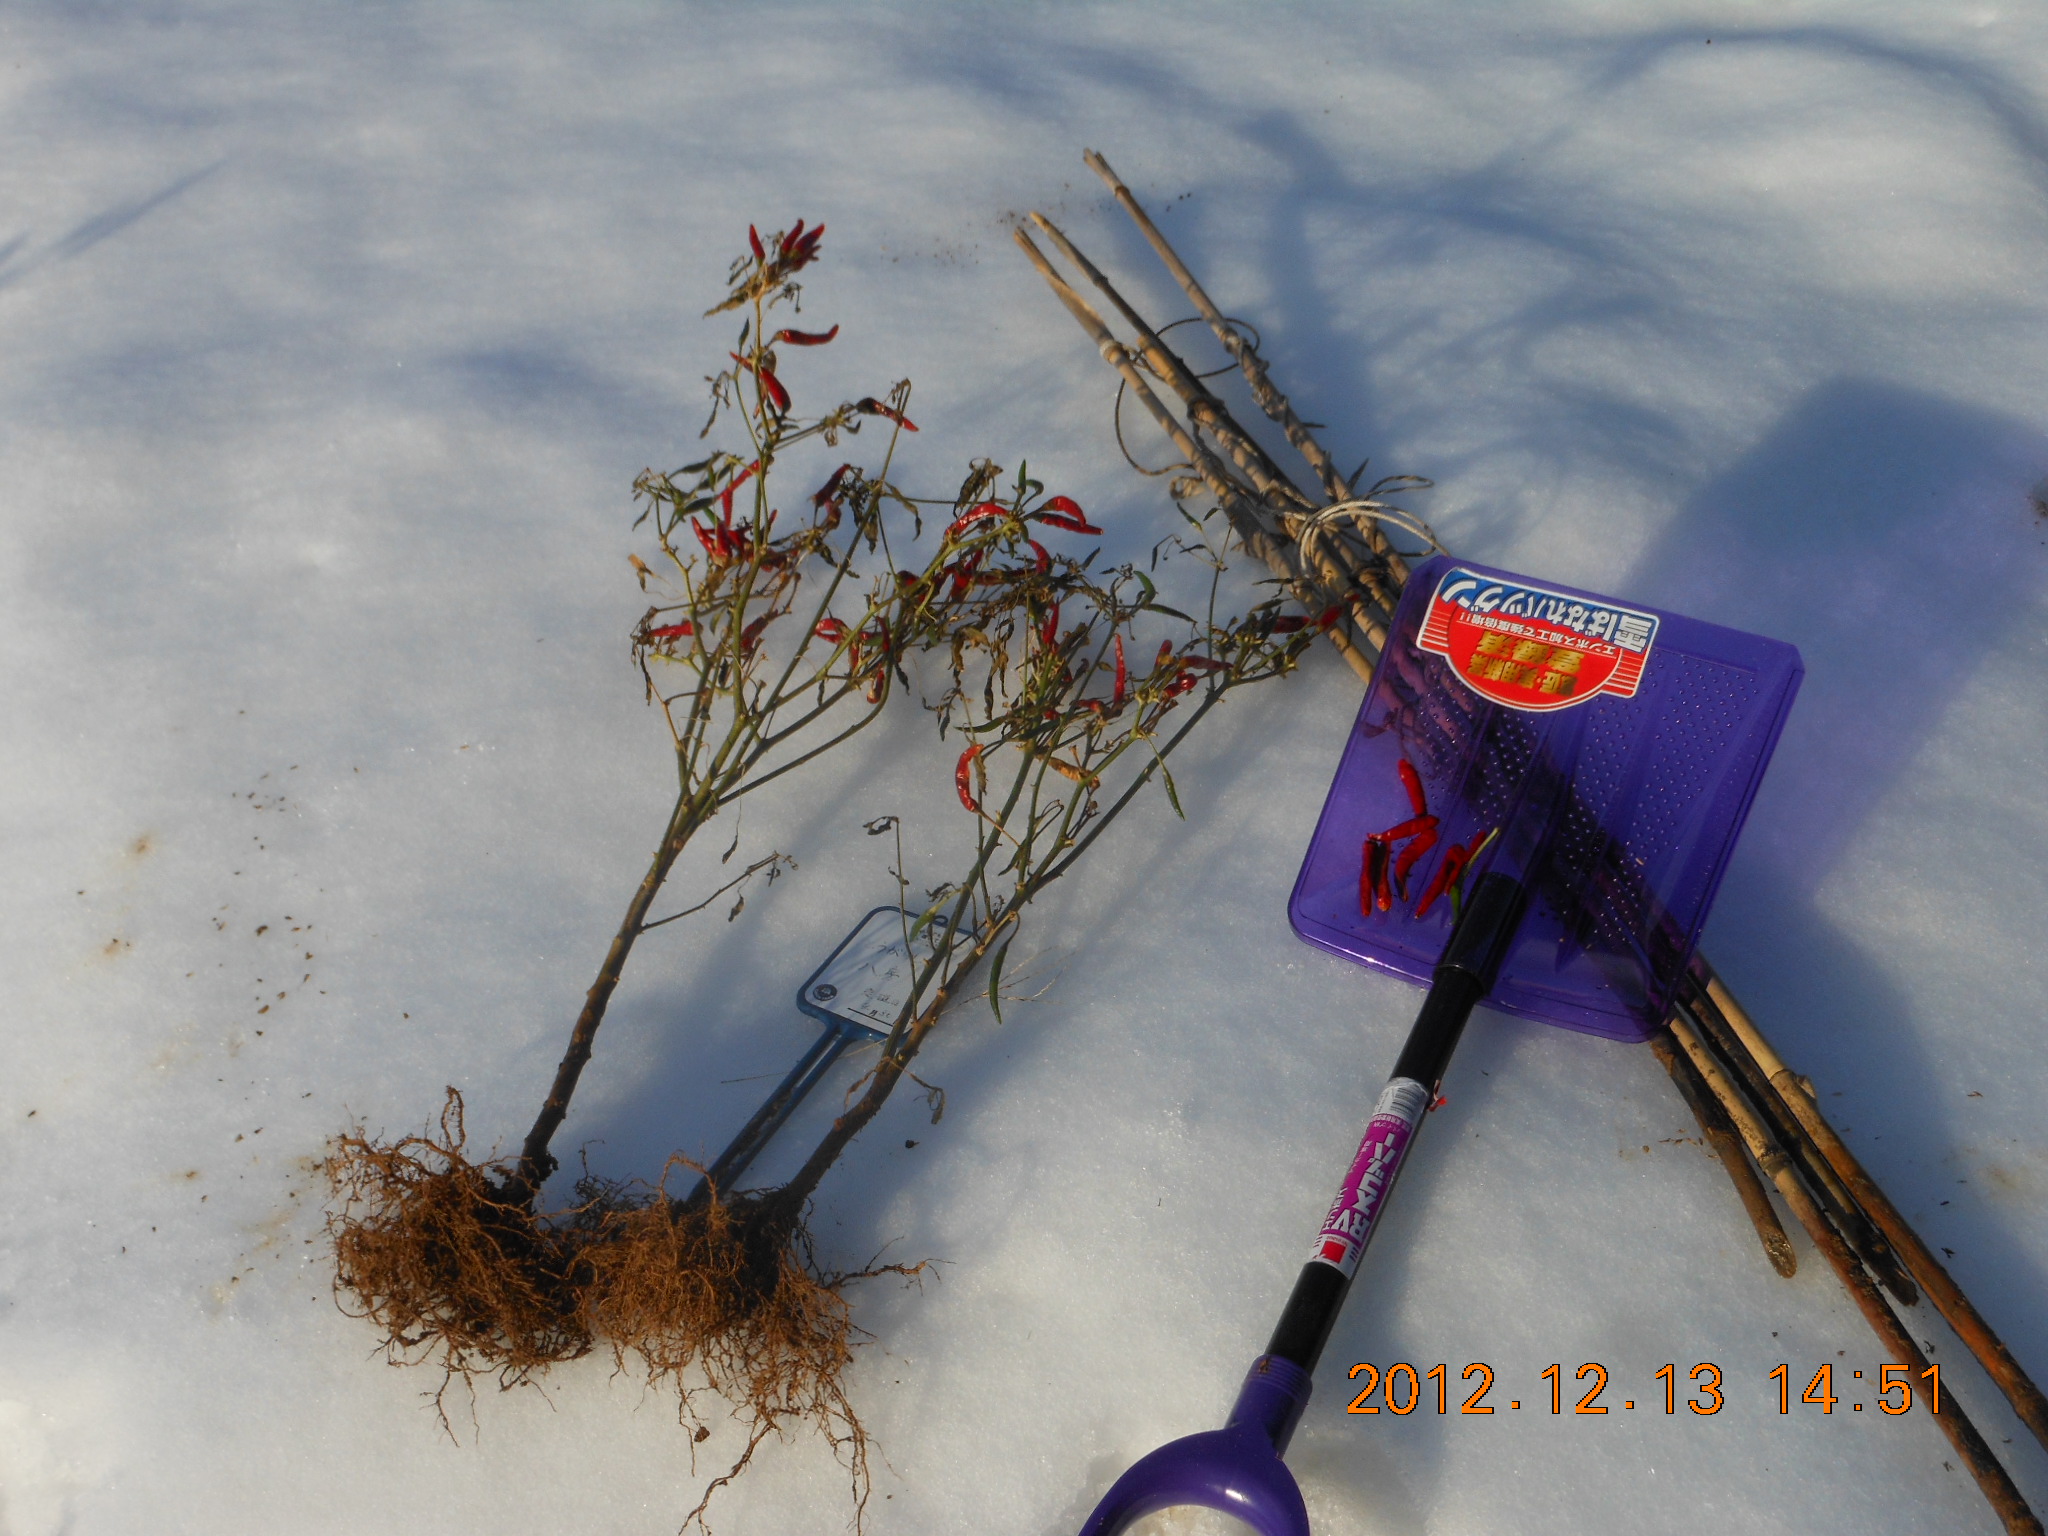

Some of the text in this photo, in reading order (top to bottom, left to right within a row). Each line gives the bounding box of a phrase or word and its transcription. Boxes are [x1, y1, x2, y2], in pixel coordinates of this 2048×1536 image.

[1442, 580, 1652, 653] 雪ばなれバツグン
[1334, 1210, 1369, 1240] RV
